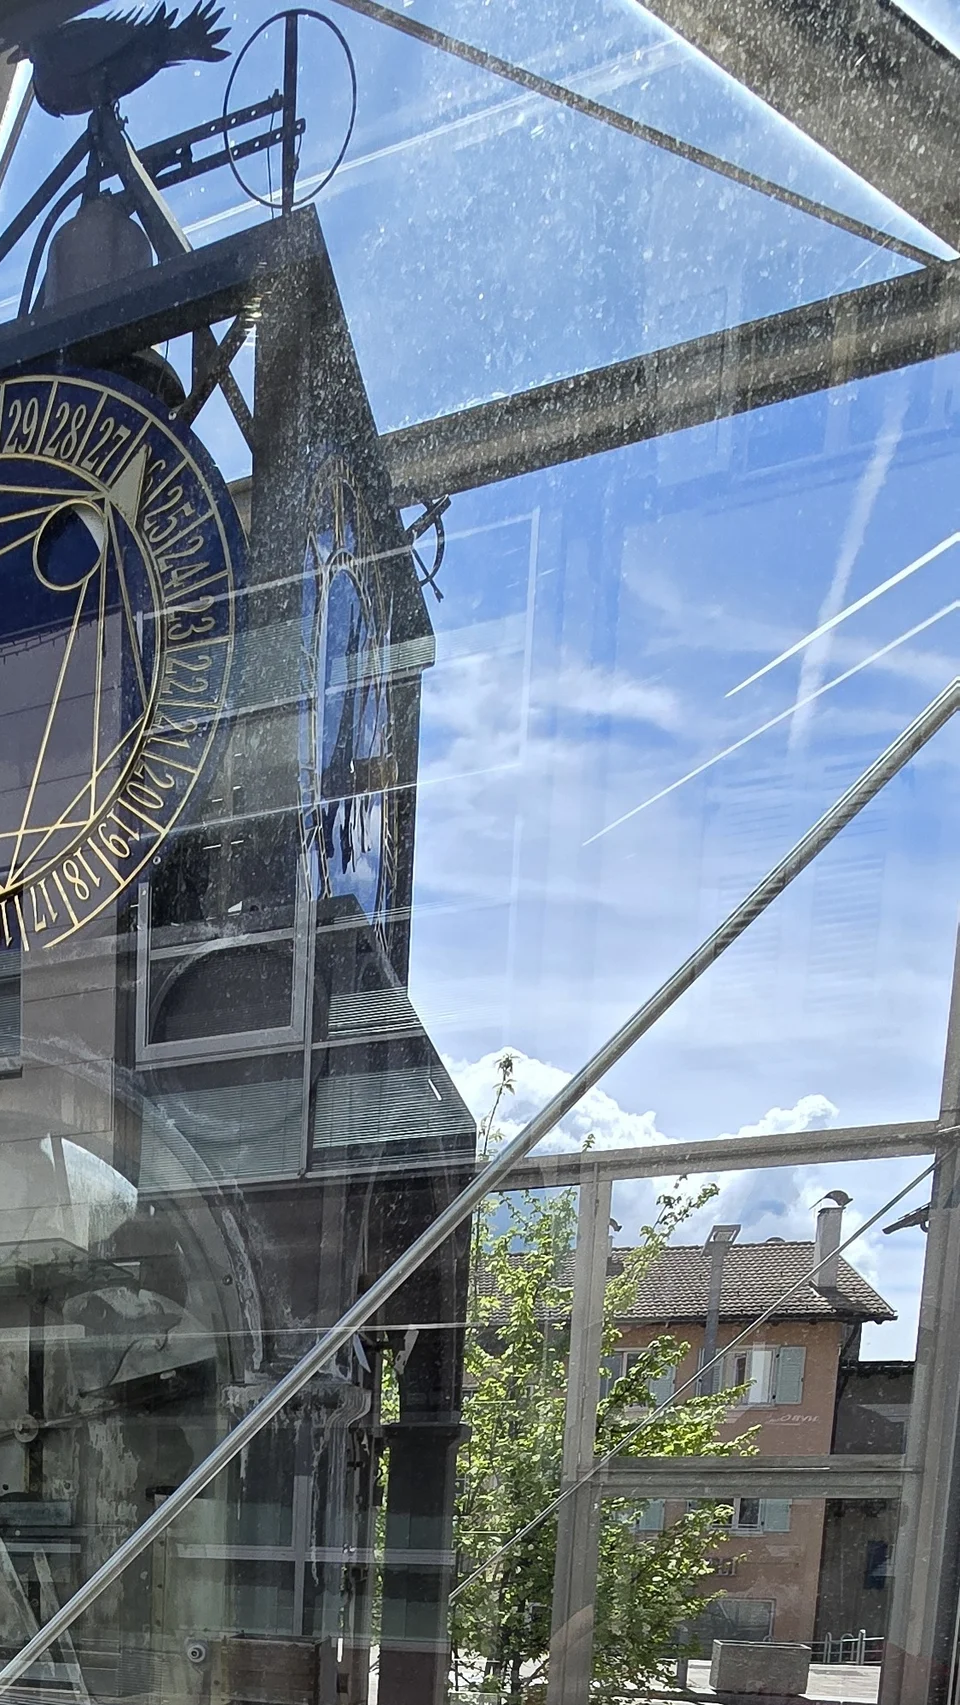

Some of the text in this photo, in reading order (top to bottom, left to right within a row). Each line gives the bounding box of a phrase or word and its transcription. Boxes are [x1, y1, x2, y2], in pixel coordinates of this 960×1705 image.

[2, 397, 39, 454] 29
[43, 402, 87, 459] 28
[80, 416, 132, 477] 27
[144, 485, 196, 544] 25
[158, 536, 210, 589] 24
[167, 596, 216, 641] 23
[162, 655, 212, 695] 22
[148, 710, 198, 749] 21
[126, 762, 176, 810] 20
[97, 808, 140, 859] 19
[62, 846, 102, 900] 18
[29, 878, 58, 933] 17
